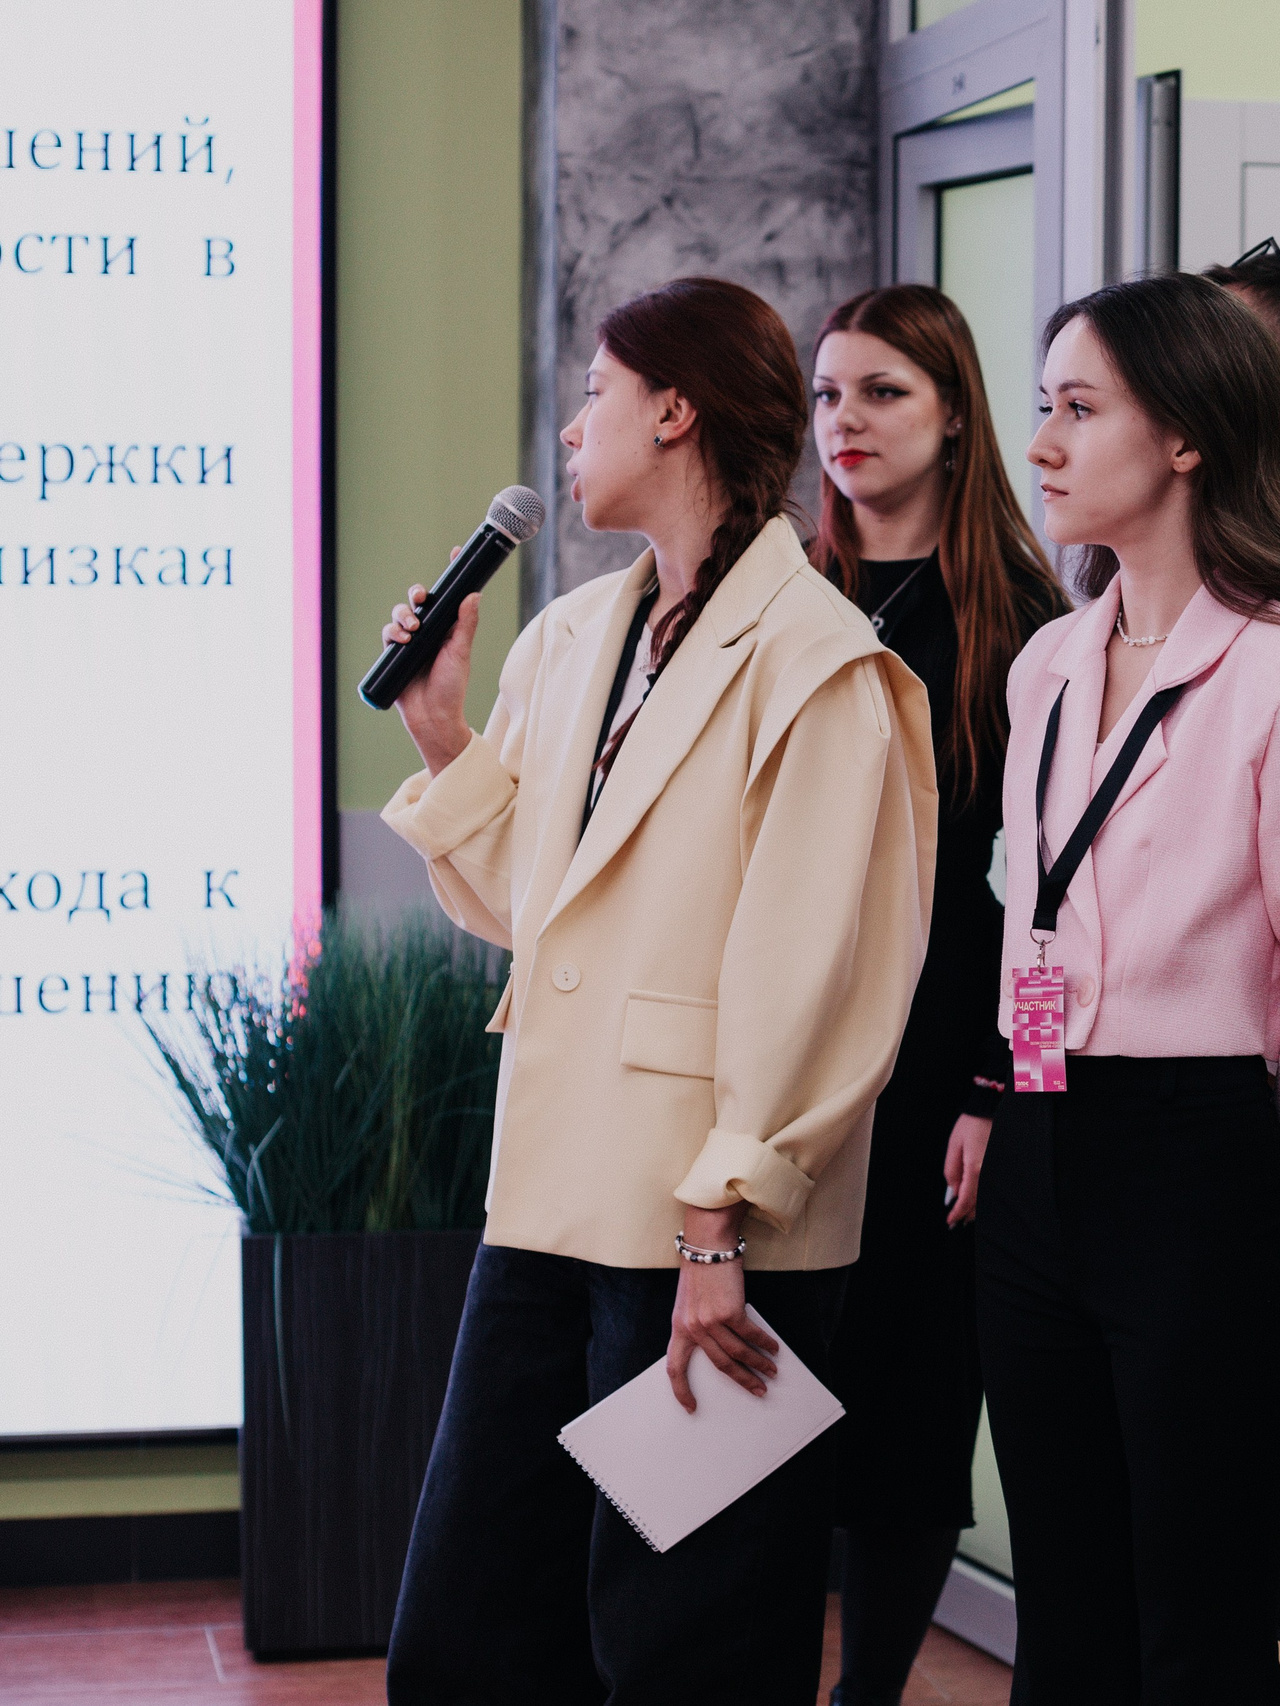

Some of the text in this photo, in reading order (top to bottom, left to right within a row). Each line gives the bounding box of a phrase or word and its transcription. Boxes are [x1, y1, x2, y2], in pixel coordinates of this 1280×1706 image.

[0, 232, 237, 278] сти в
[0, 441, 235, 501] ержки
[0, 546, 233, 586] изкая
[203, 870, 239, 909] к
[1013, 1000, 1056, 1012] УЧАСТНИК
